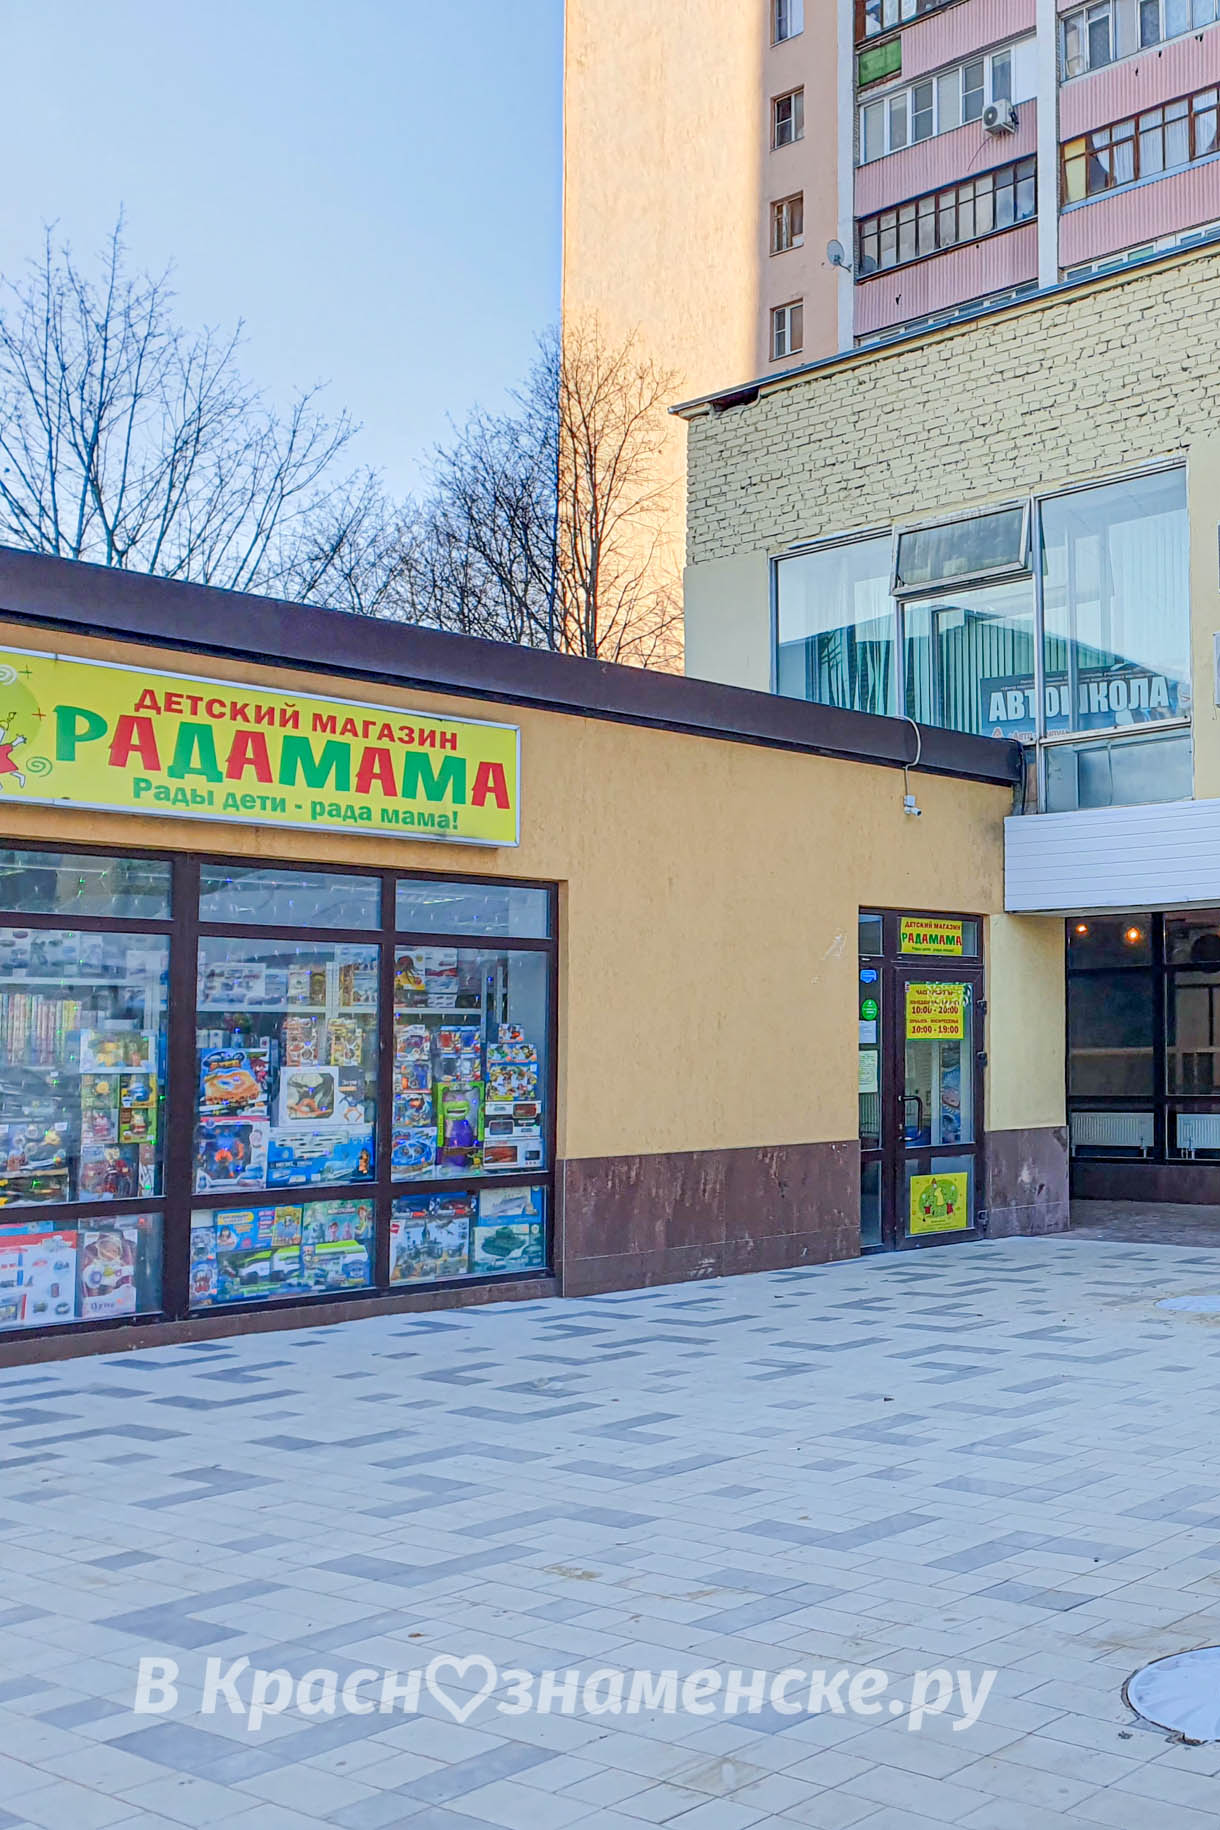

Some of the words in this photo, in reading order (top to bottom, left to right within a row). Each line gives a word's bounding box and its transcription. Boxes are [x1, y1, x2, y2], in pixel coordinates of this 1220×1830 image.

[134, 688, 300, 730] ДЕТСКИЙ
[312, 712, 457, 751] МАГАЗИН
[53, 704, 511, 810] РАДАМАМА
[133, 777, 214, 807] Рады
[222, 792, 287, 813] дети
[311, 800, 372, 823] рада
[381, 808, 459, 830] мама!
[902, 932, 962, 947] РАДАМАМА
[912, 1005, 932, 1014] 10:00
[911, 1025, 932, 1034] 10:00
[938, 1024, 959, 1034] 19:00
